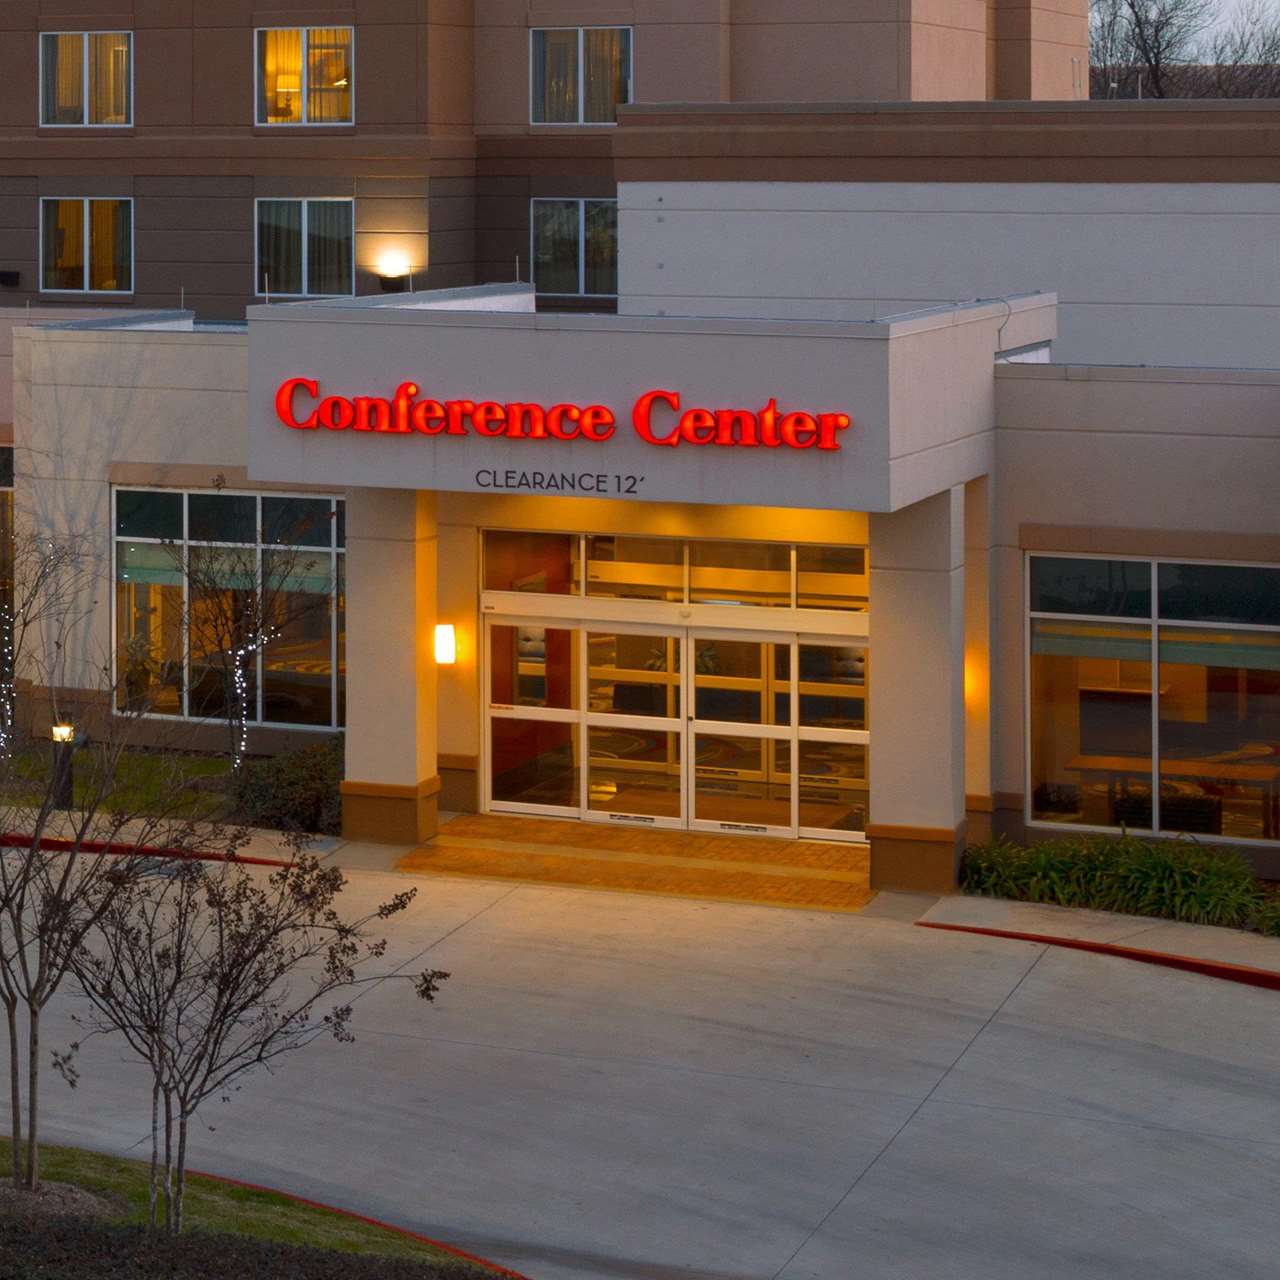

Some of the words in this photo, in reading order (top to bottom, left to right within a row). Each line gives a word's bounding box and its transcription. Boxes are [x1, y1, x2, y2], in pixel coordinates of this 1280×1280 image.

[275, 377, 615, 441] Conference
[633, 390, 851, 451] Center
[475, 469, 608, 493] CLEARANCE
[615, 475, 645, 494] 12'
